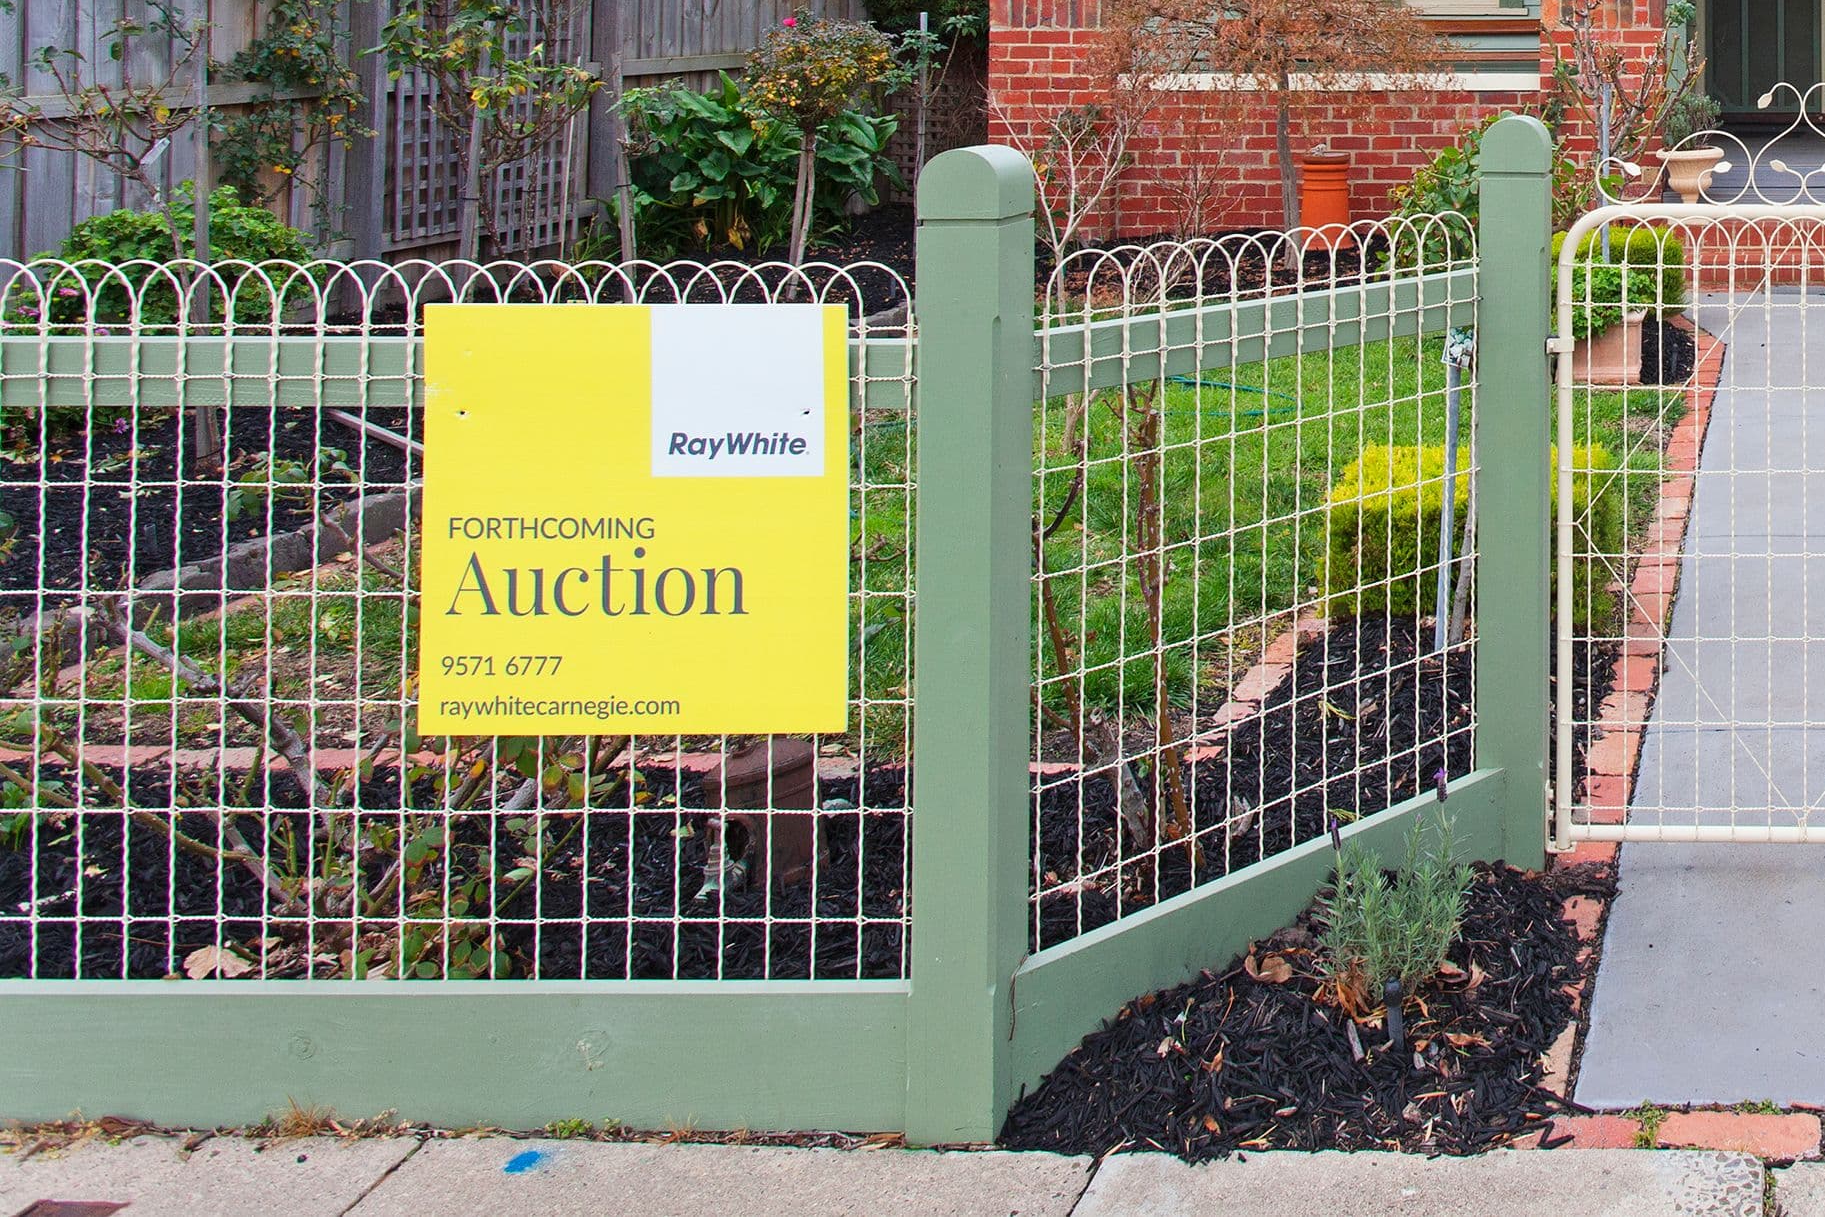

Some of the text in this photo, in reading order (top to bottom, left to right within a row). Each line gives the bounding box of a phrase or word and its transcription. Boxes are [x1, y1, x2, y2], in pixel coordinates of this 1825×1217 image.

[448, 517, 655, 539] FORTHCOMING
[445, 546, 749, 616] Auction
[441, 655, 563, 676] 9571 6777
[440, 695, 680, 720] raywhitecarnegie.com
